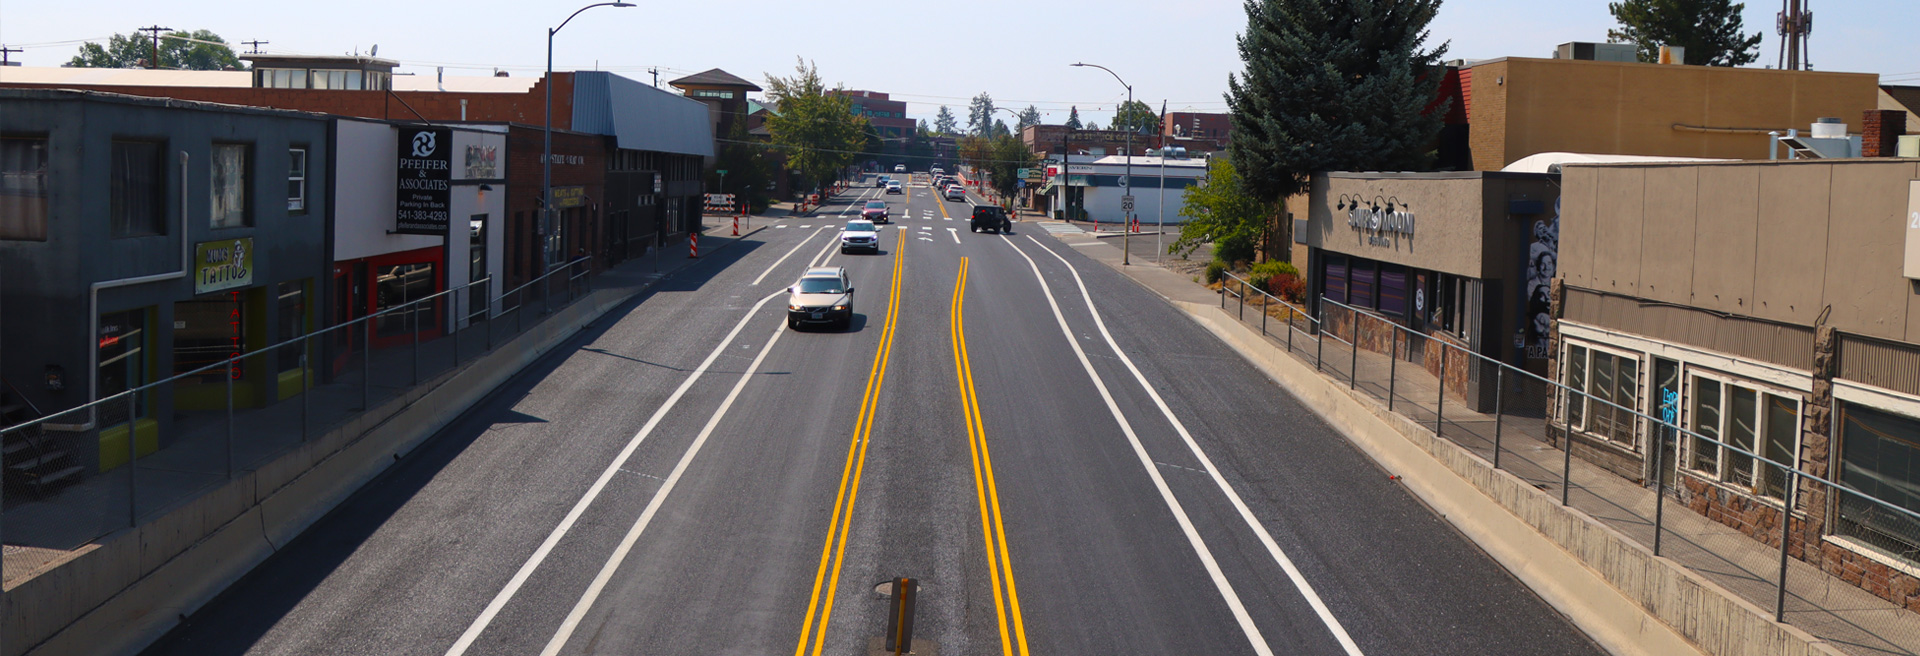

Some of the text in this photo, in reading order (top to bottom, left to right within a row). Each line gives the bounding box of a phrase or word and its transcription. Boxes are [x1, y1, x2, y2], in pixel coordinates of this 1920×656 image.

[400, 158, 448, 170] PFEIFER
[418, 169, 427, 178] &
[400, 178, 448, 190] ASSOCIATES
[1123, 202, 1133, 210] 20
[398, 210, 447, 221] 541-383-4293
[1911, 211, 1920, 229] 2
[1381, 210, 1414, 234] MOON
[202, 264, 247, 285] TATTOO
[230, 291, 241, 379] TATTOO
